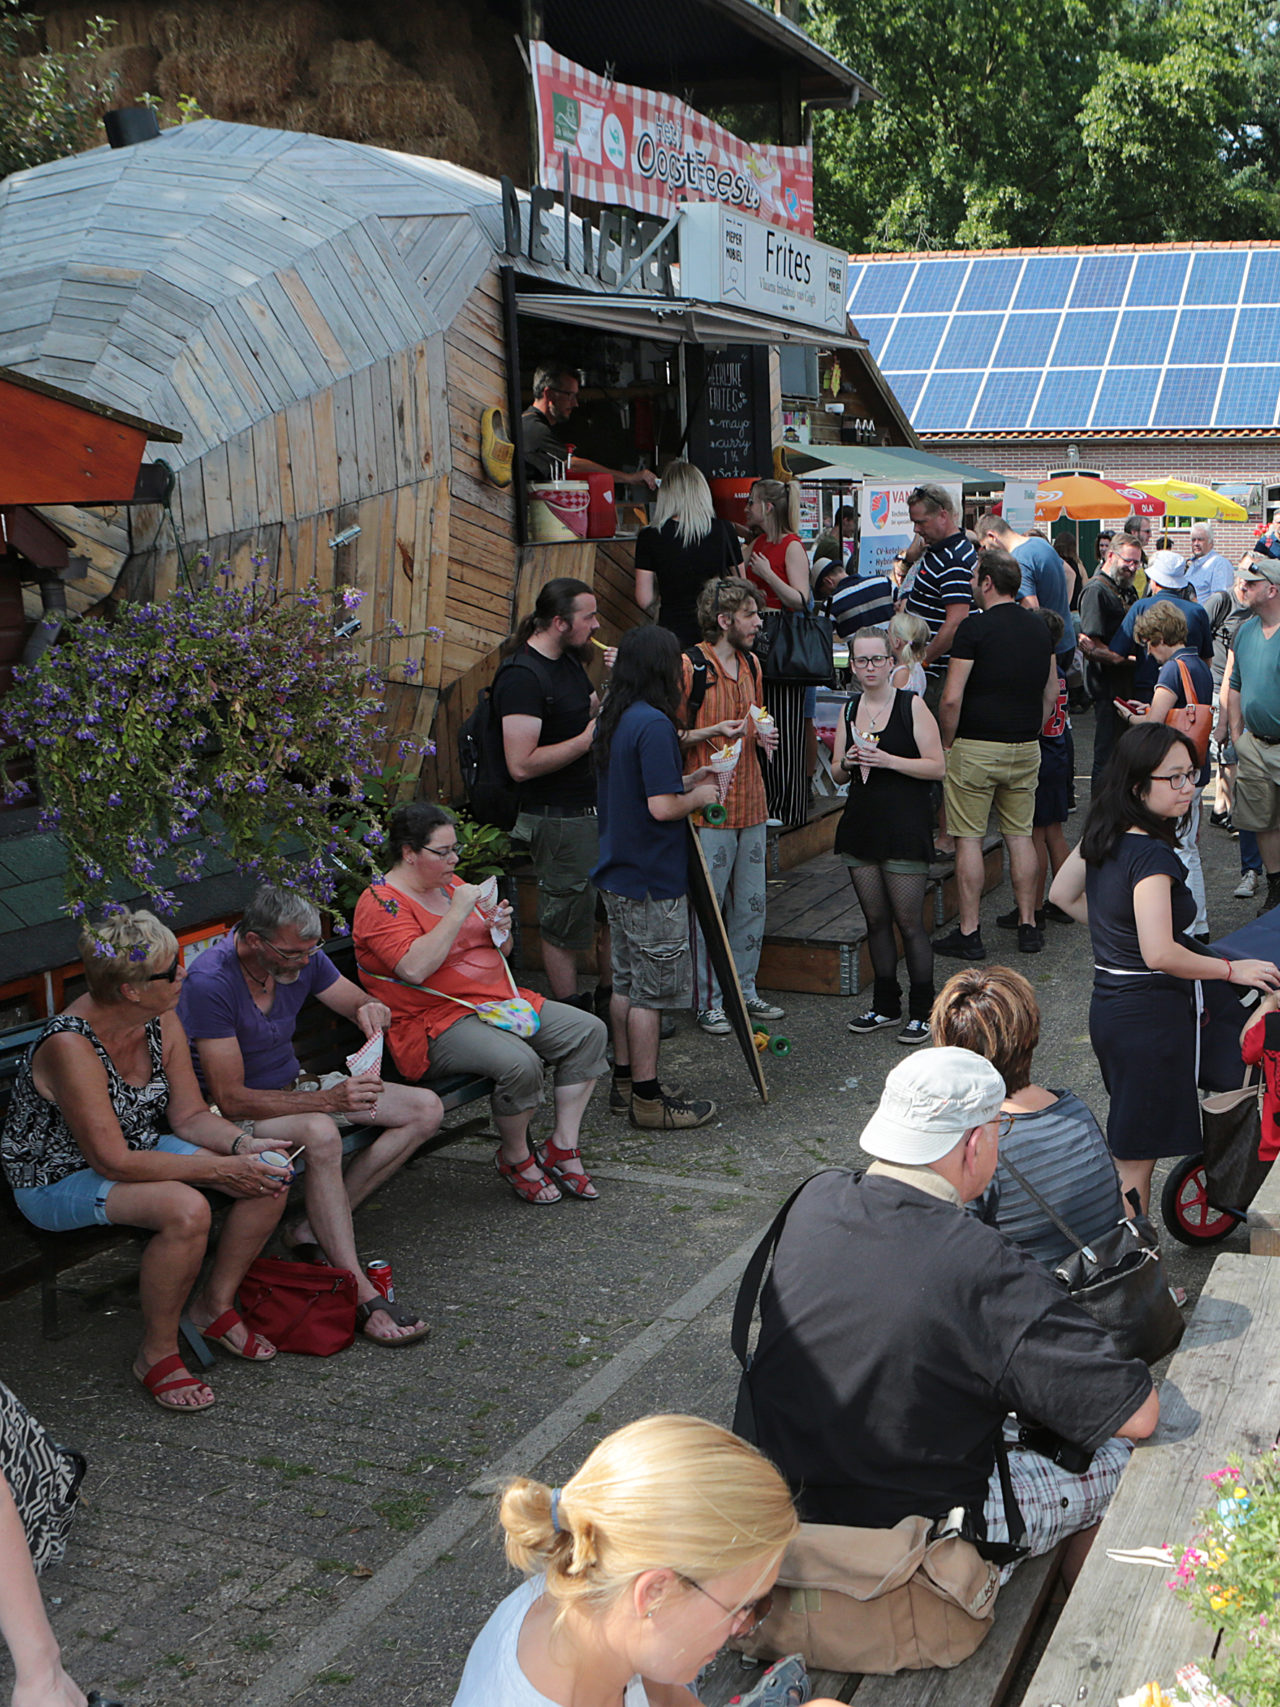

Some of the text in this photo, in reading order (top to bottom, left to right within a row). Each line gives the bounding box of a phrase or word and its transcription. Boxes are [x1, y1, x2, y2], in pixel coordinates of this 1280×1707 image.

[766, 230, 811, 285] Frites
[709, 387, 739, 413] FRITES
[717, 420, 750, 439] mayo
[715, 439, 751, 456] curry
